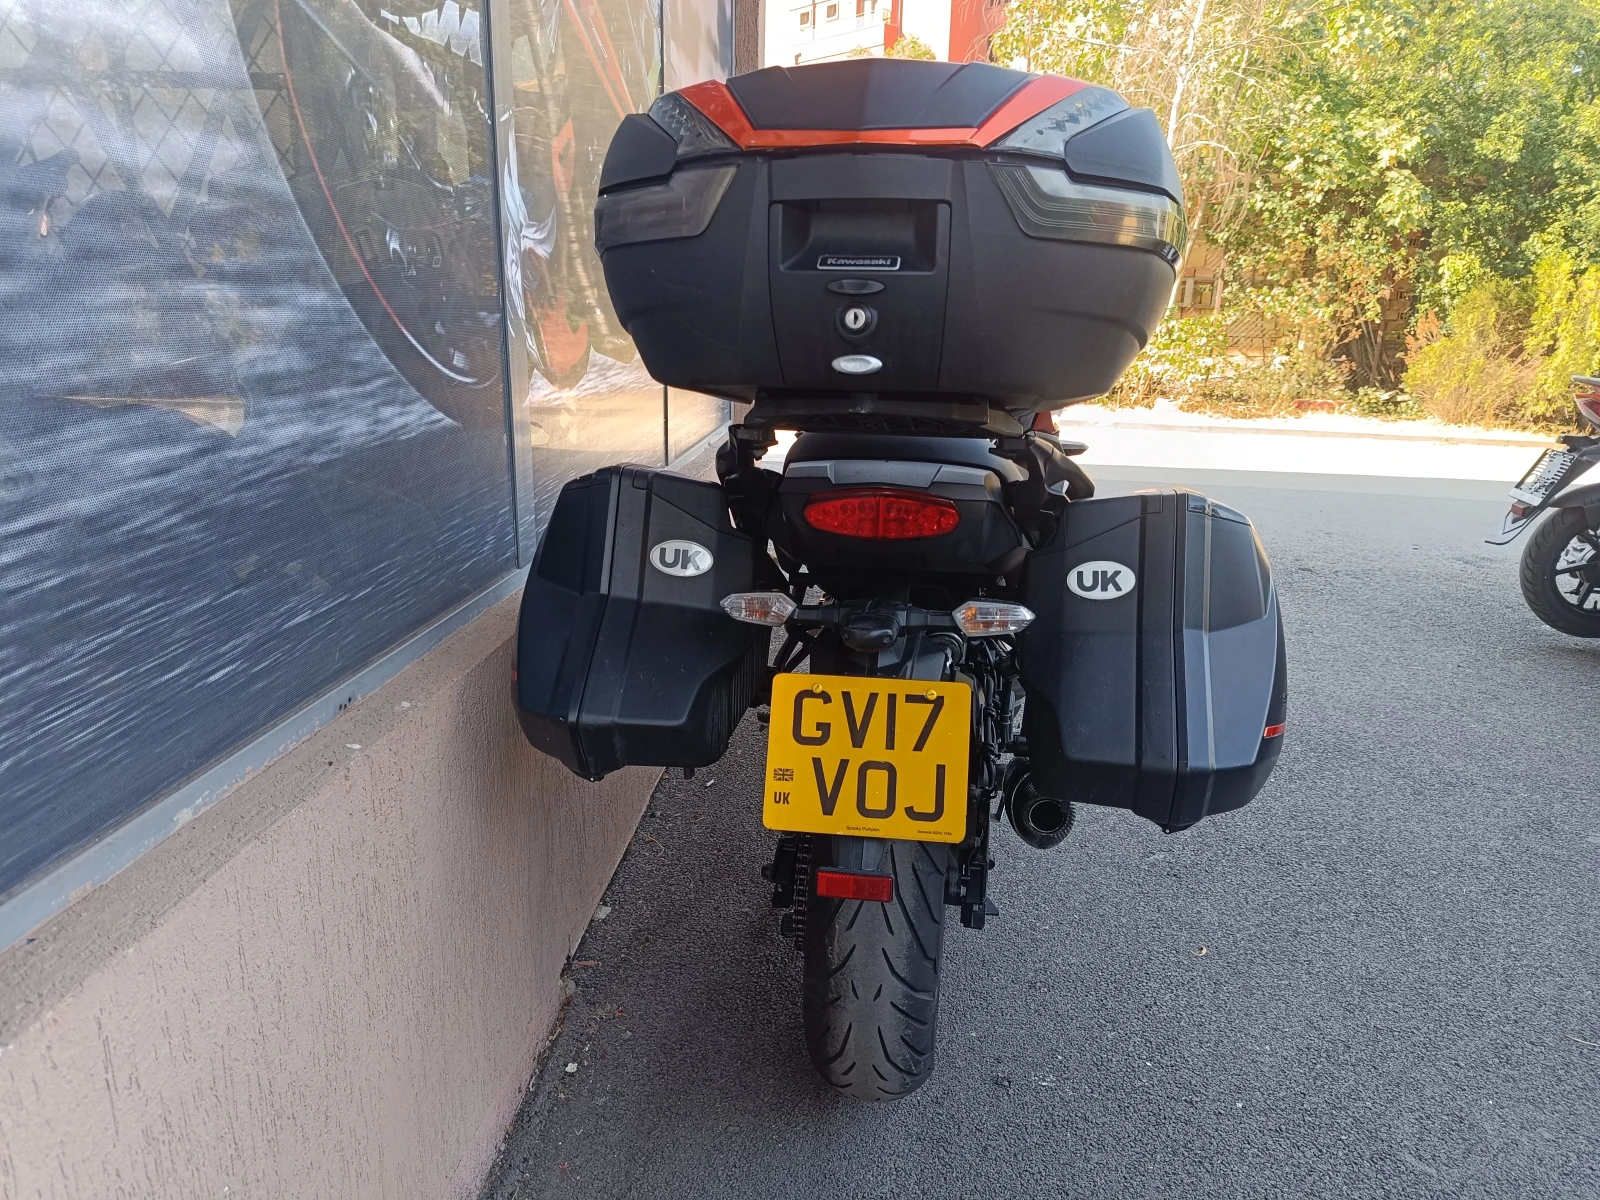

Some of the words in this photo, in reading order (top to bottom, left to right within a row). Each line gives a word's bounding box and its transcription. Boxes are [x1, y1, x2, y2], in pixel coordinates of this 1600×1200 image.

[659, 547, 701, 571] UK
[1076, 570, 1123, 592] UK
[792, 689, 945, 752] GV17
[774, 791, 790, 805] UK
[811, 757, 946, 822] VOJ
